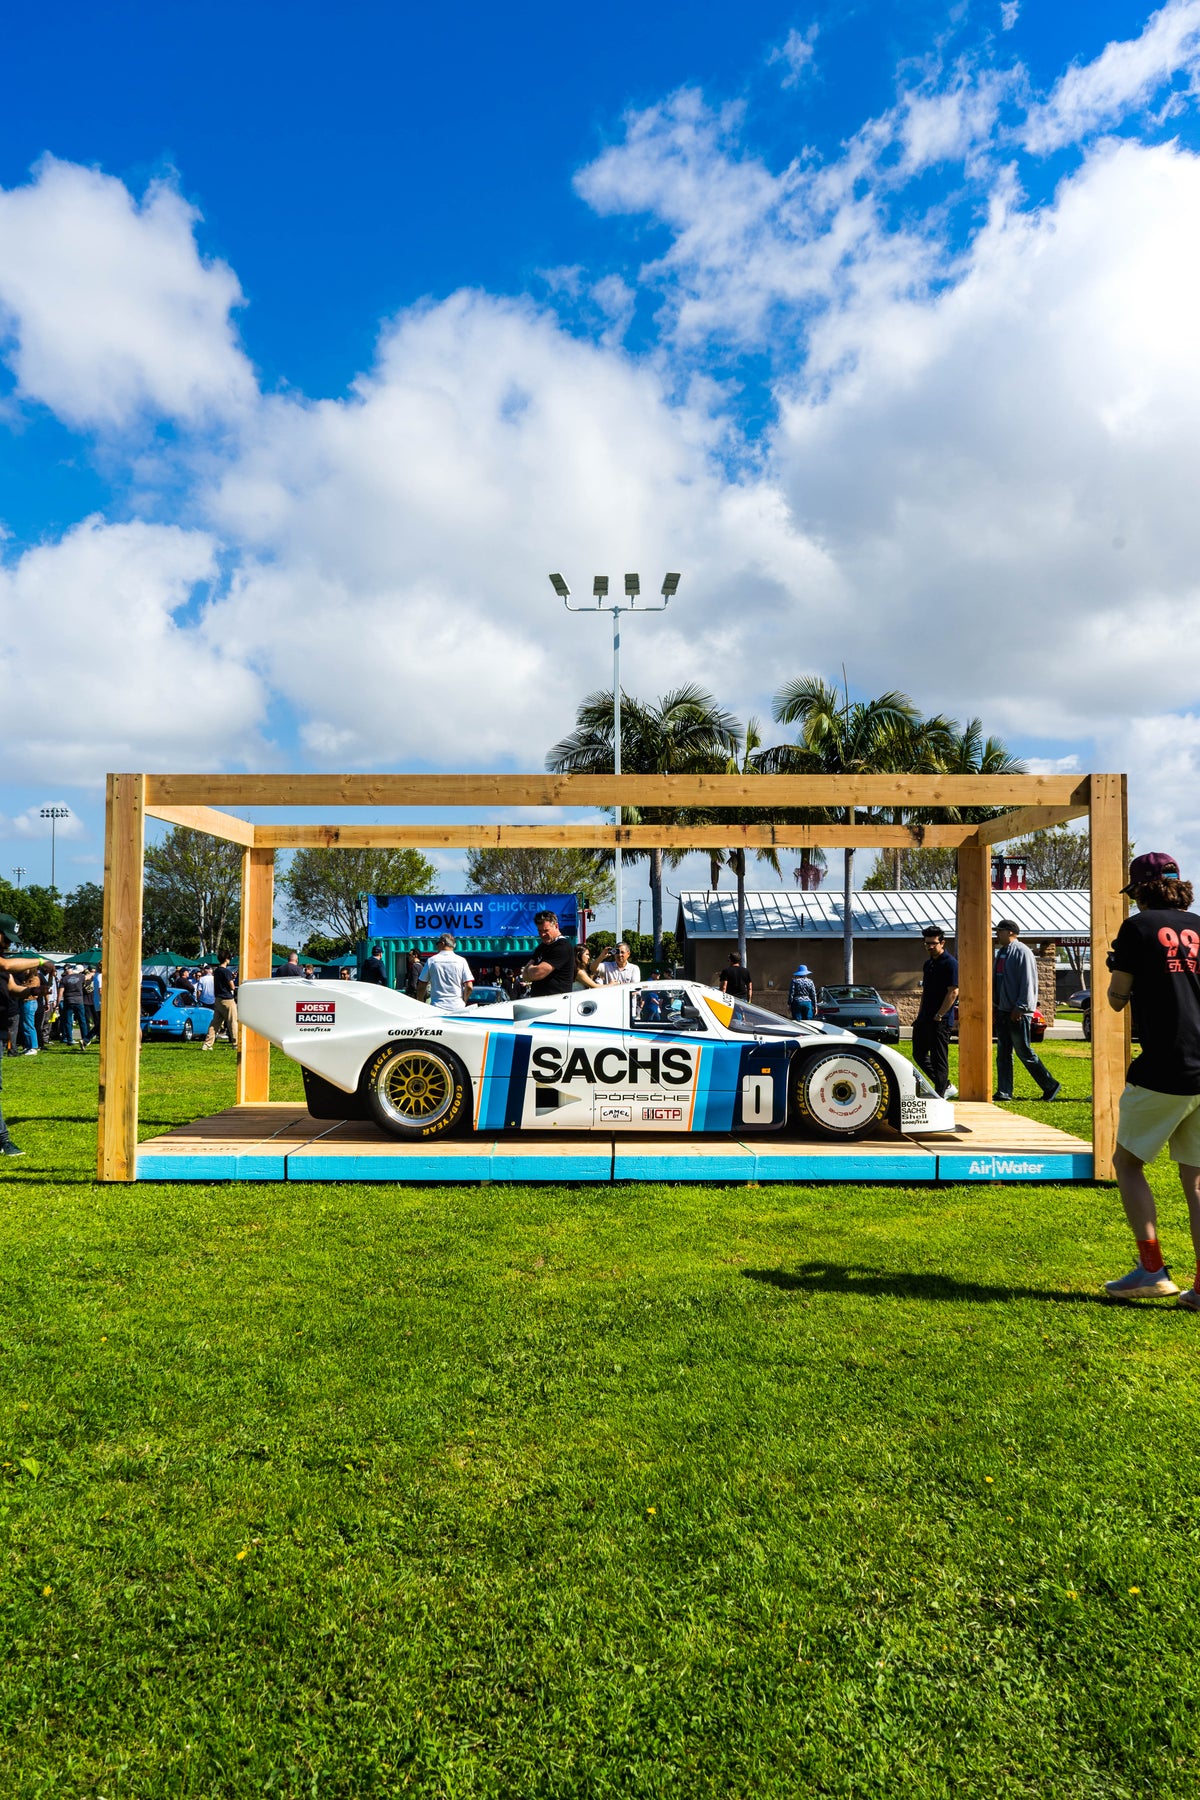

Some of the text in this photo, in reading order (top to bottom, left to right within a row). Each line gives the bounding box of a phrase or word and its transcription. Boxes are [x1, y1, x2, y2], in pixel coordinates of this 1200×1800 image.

[414, 901, 547, 913] HAWAIIAN CHICKEN
[414, 914, 484, 930] BOWLS
[1157, 926, 1200, 958] 99
[301, 1004, 330, 1012] JOEST
[298, 1014, 333, 1022] RACING
[387, 1027, 443, 1037] GOODYEAR
[369, 1047, 394, 1079] EAGLE
[531, 1046, 693, 1084] SACHS
[824, 1069, 859, 1082] PORSCHE
[867, 1057, 889, 1120] GOODYEAR
[594, 1093, 690, 1101] PORSCHE
[796, 1080, 810, 1116] EAGLE
[422, 1085, 463, 1136] GOODYEAR
[602, 1109, 630, 1117] CAMEL
[655, 1109, 681, 1119] GTP
